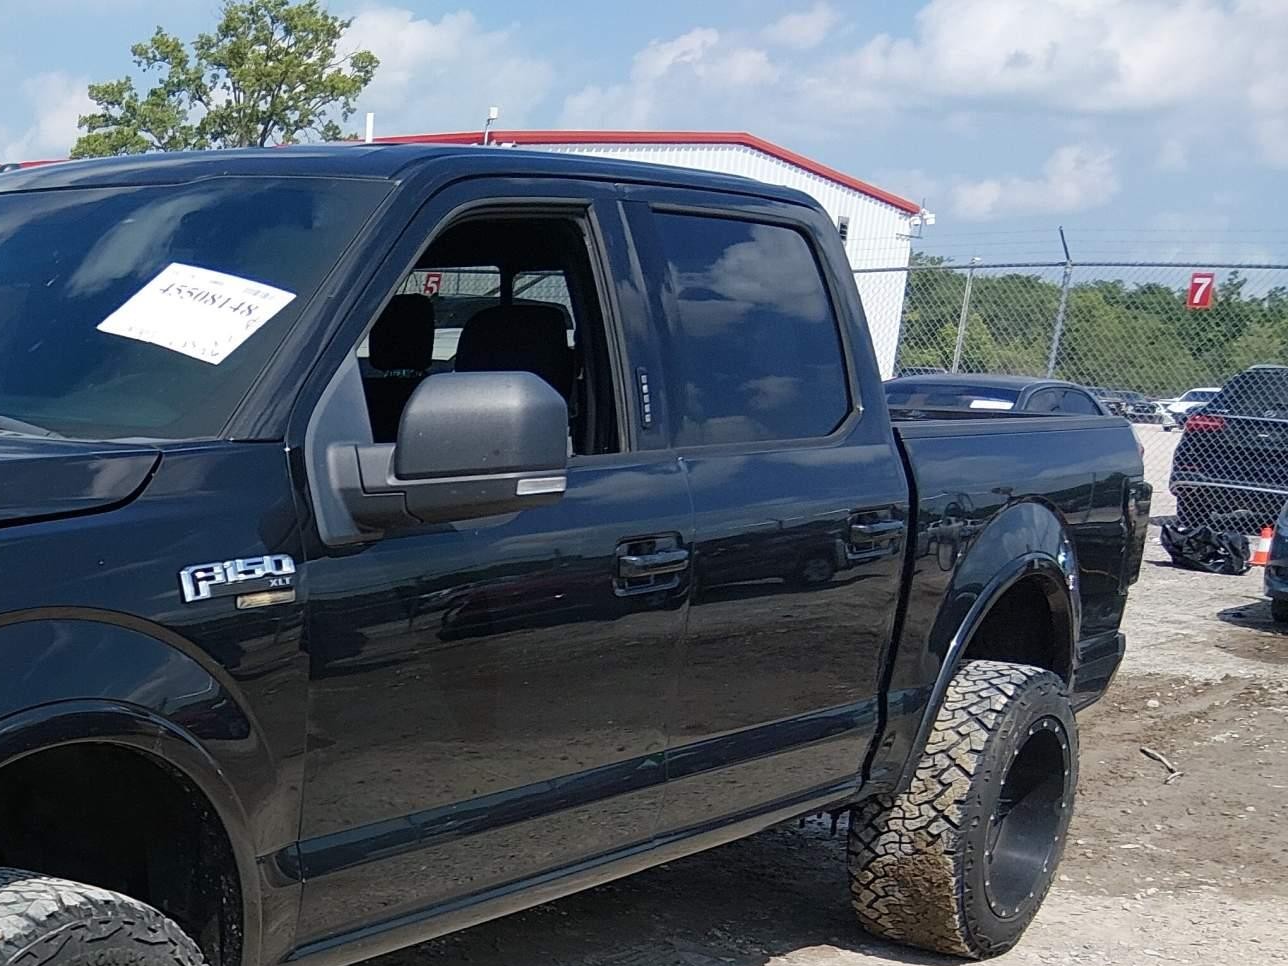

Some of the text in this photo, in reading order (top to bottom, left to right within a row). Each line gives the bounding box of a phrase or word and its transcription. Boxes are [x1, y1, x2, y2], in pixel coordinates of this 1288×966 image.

[426, 276, 440, 297] 5
[1192, 277, 1212, 304] 7
[159, 282, 260, 317] 45508148
[268, 576, 292, 588] XLT
